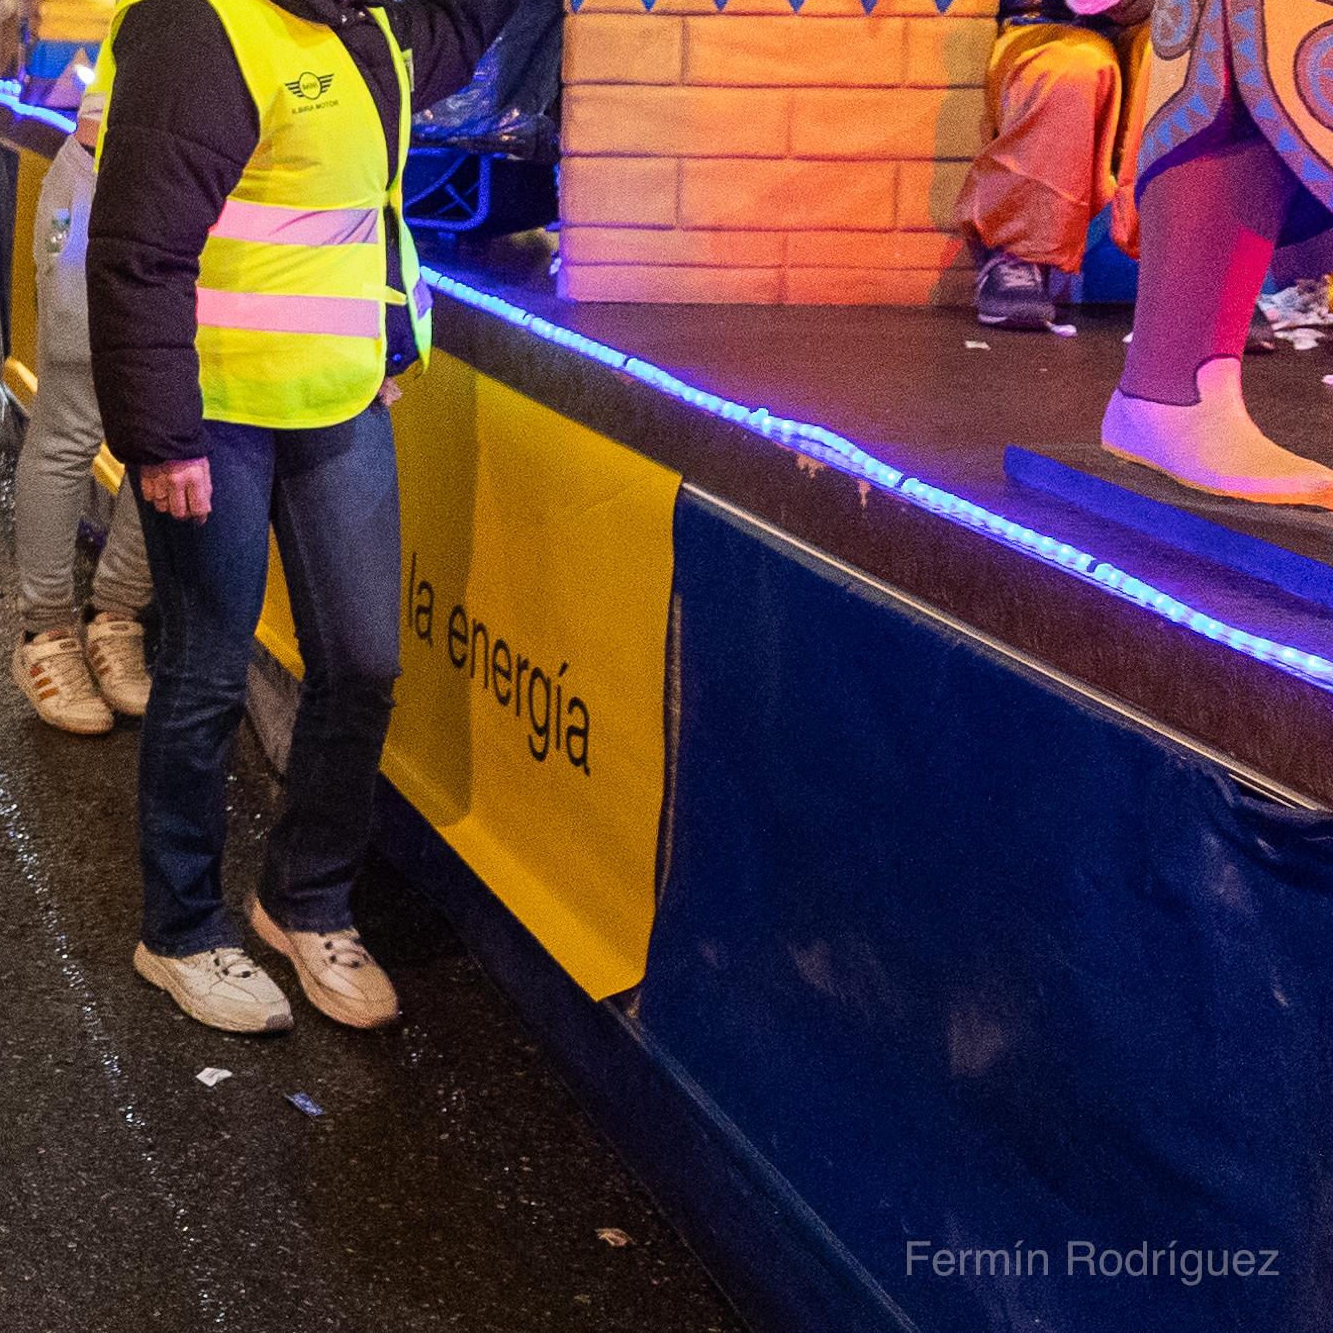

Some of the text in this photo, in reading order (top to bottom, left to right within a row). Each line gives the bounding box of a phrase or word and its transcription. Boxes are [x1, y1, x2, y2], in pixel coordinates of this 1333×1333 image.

[315, 99, 339, 109] MOTOR
[407, 551, 590, 777] la energía
